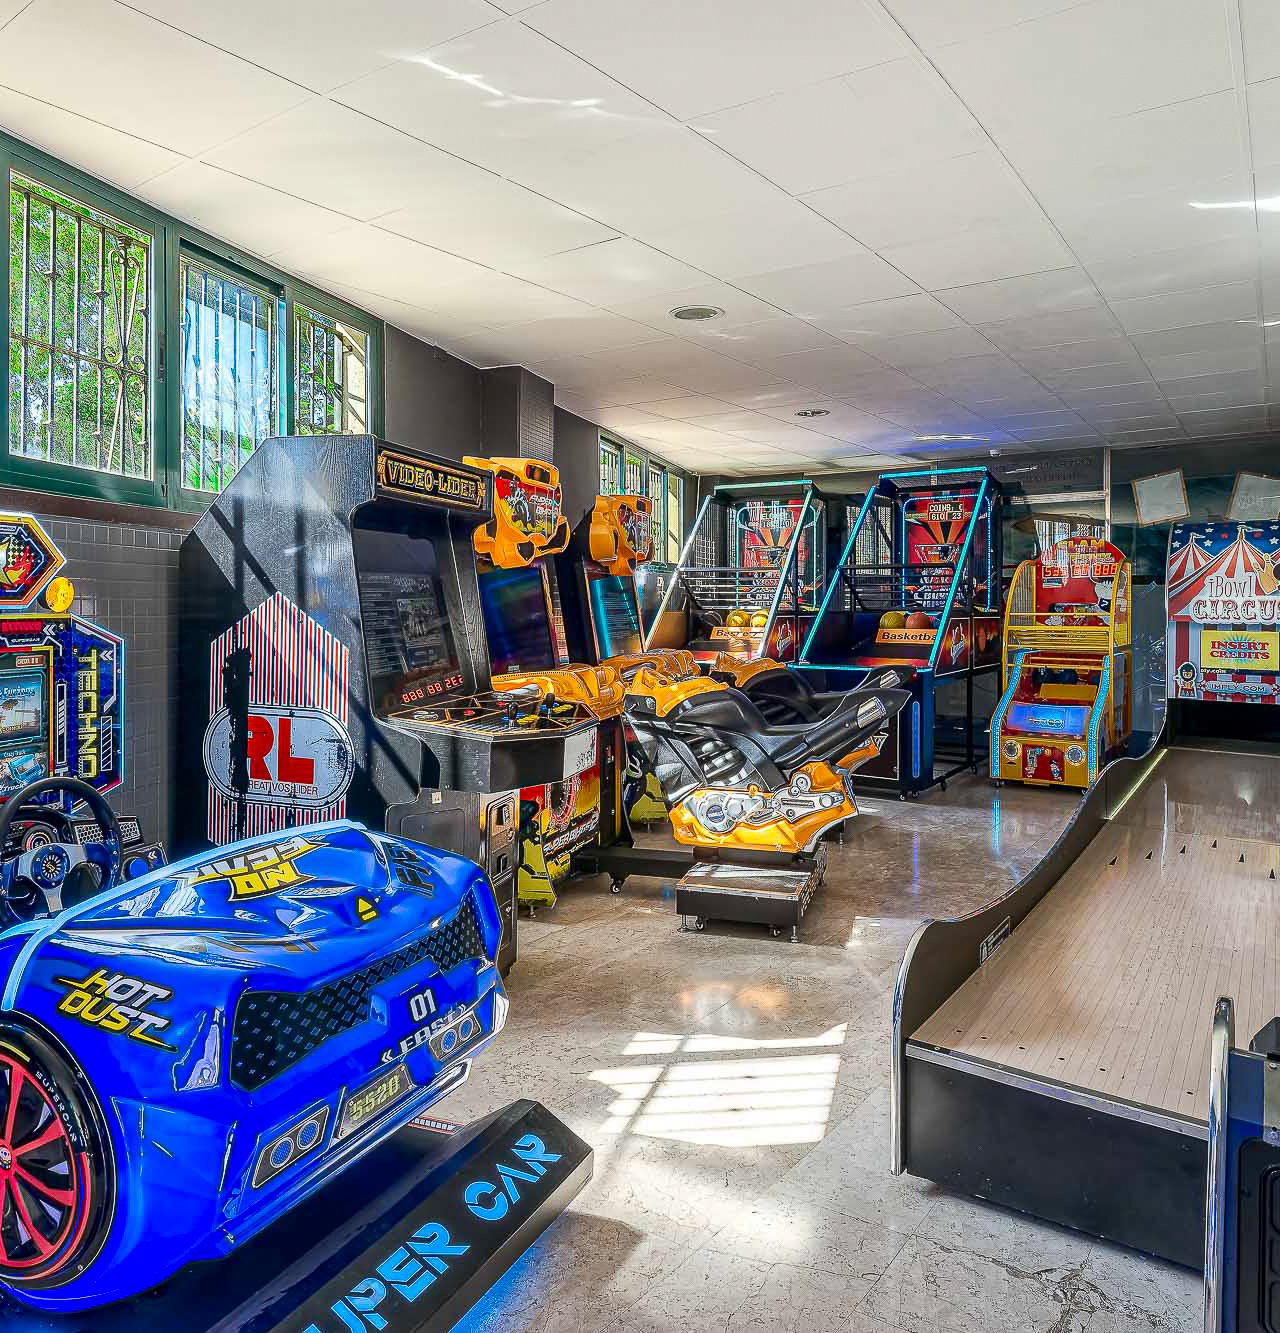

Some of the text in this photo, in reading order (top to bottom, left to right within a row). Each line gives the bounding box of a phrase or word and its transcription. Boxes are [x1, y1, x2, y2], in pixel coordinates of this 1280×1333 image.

[387, 460, 477, 499] VIDEO-LIDER
[1208, 575, 1253, 598] iBowl
[882, 632, 936, 640] Basketba
[1210, 640, 1270, 651] INSERT
[1209, 650, 1270, 660] CREDITS
[78, 649, 97, 778] TECHNO
[248, 780, 291, 793] REATIVOS
[58, 969, 171, 1008] HOT
[409, 988, 437, 1022] 01
[59, 990, 174, 1049] DUST
[302, 1134, 562, 1333] UPER CAR
